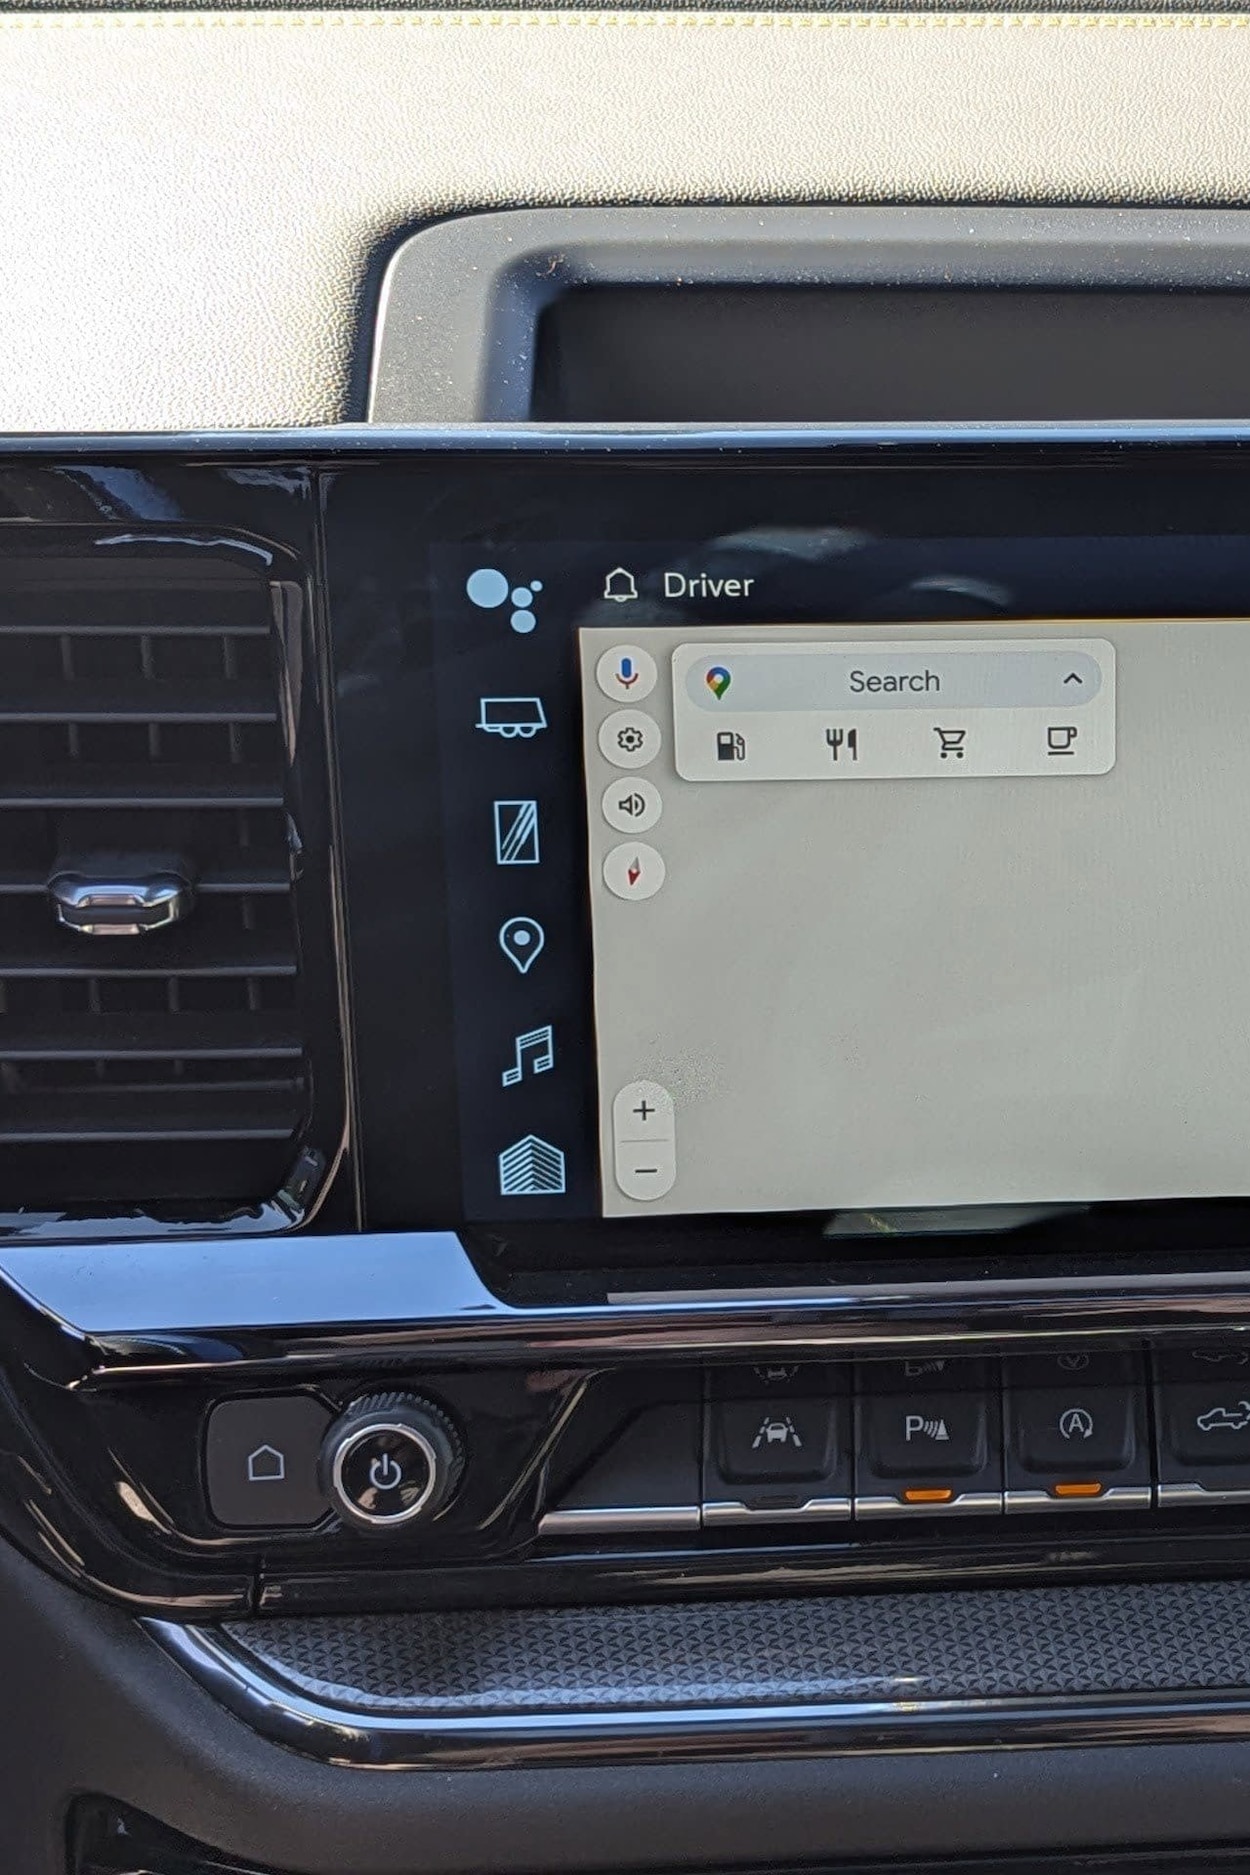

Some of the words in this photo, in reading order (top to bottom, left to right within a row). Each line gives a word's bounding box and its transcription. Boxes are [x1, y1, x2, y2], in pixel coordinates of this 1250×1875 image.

[663, 572, 754, 598] Driver
[849, 669, 940, 693] Search
[905, 1415, 924, 1440] P
[1069, 1414, 1084, 1432] A
